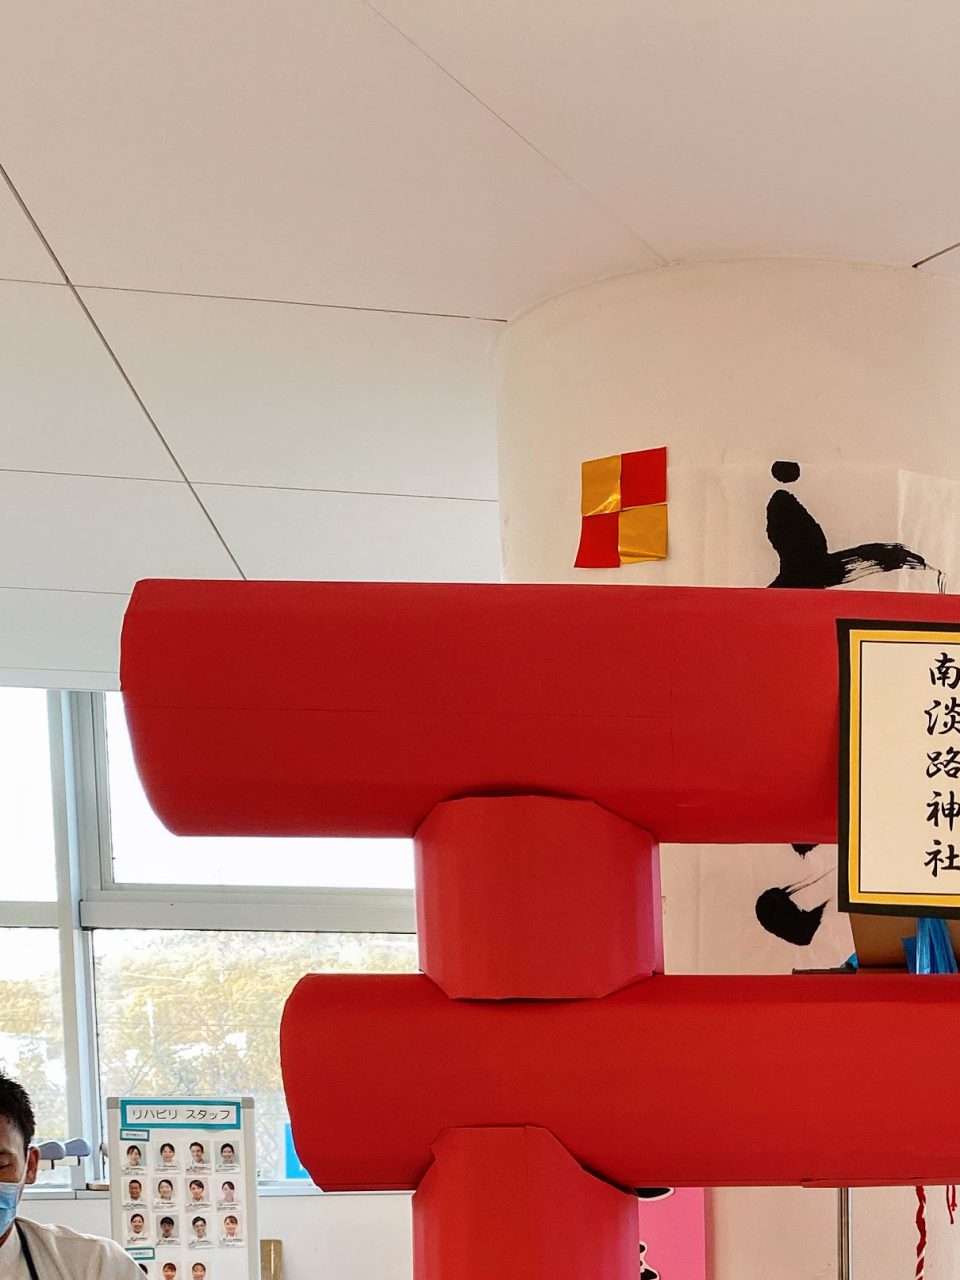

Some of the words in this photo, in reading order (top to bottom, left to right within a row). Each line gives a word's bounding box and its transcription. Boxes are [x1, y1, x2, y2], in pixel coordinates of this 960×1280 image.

[132, 1109, 178, 1120] リハビリ
[185, 1108, 231, 1120] スタッフ
